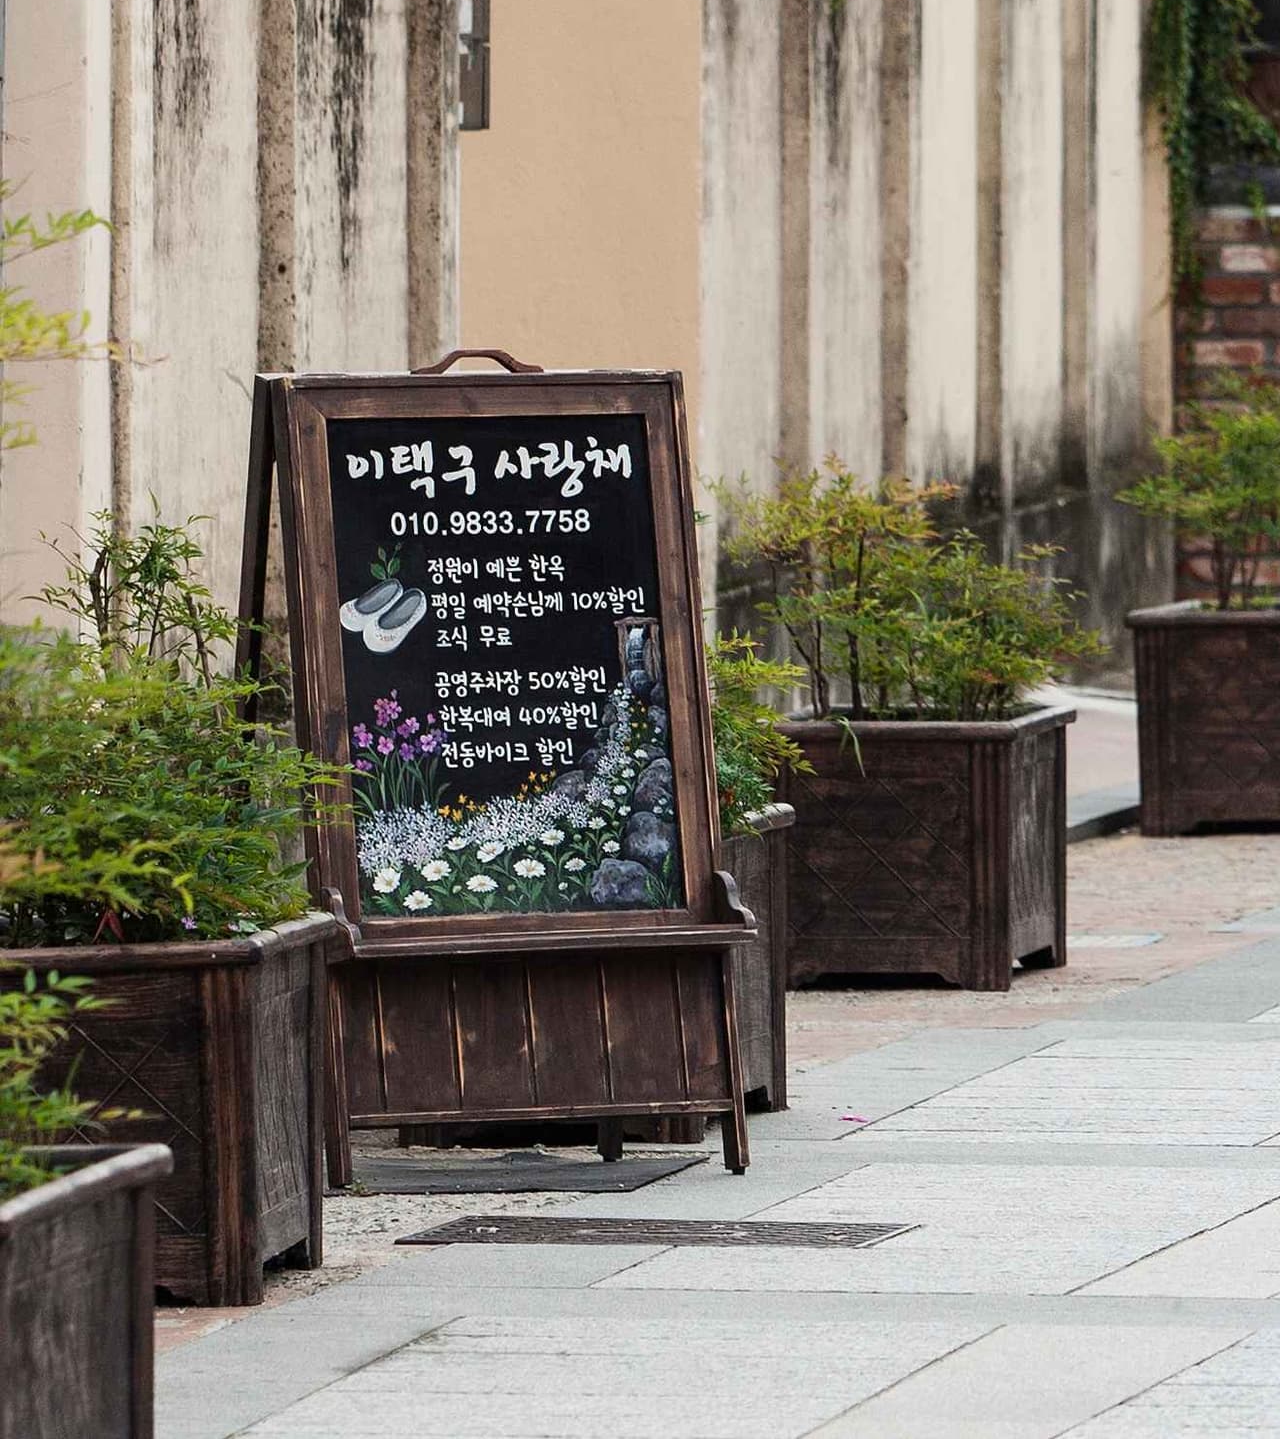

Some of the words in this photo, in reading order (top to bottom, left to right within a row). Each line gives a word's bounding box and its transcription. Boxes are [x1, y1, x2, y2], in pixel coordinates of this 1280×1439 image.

[345, 440, 476, 499] 이택구
[494, 436, 633, 498] 사랑채
[390, 508, 591, 536] 010.9833.7758
[427, 556, 479, 585] 정원이
[485, 556, 523, 583] 예쁜
[527, 553, 565, 582] 한옥
[430, 591, 466, 620] 평일
[472, 590, 564, 618] 예약손님께
[571, 585, 645, 615] 10%할인
[436, 624, 468, 652] 조식
[479, 625, 513, 648] 무료
[434, 668, 523, 699] 공영주차장
[528, 665, 607, 695] 50%할인
[437, 704, 511, 735] 한복대여
[518, 700, 598, 730] 40%할인
[441, 741, 530, 769] 전동바이크
[535, 736, 574, 766] 할인
